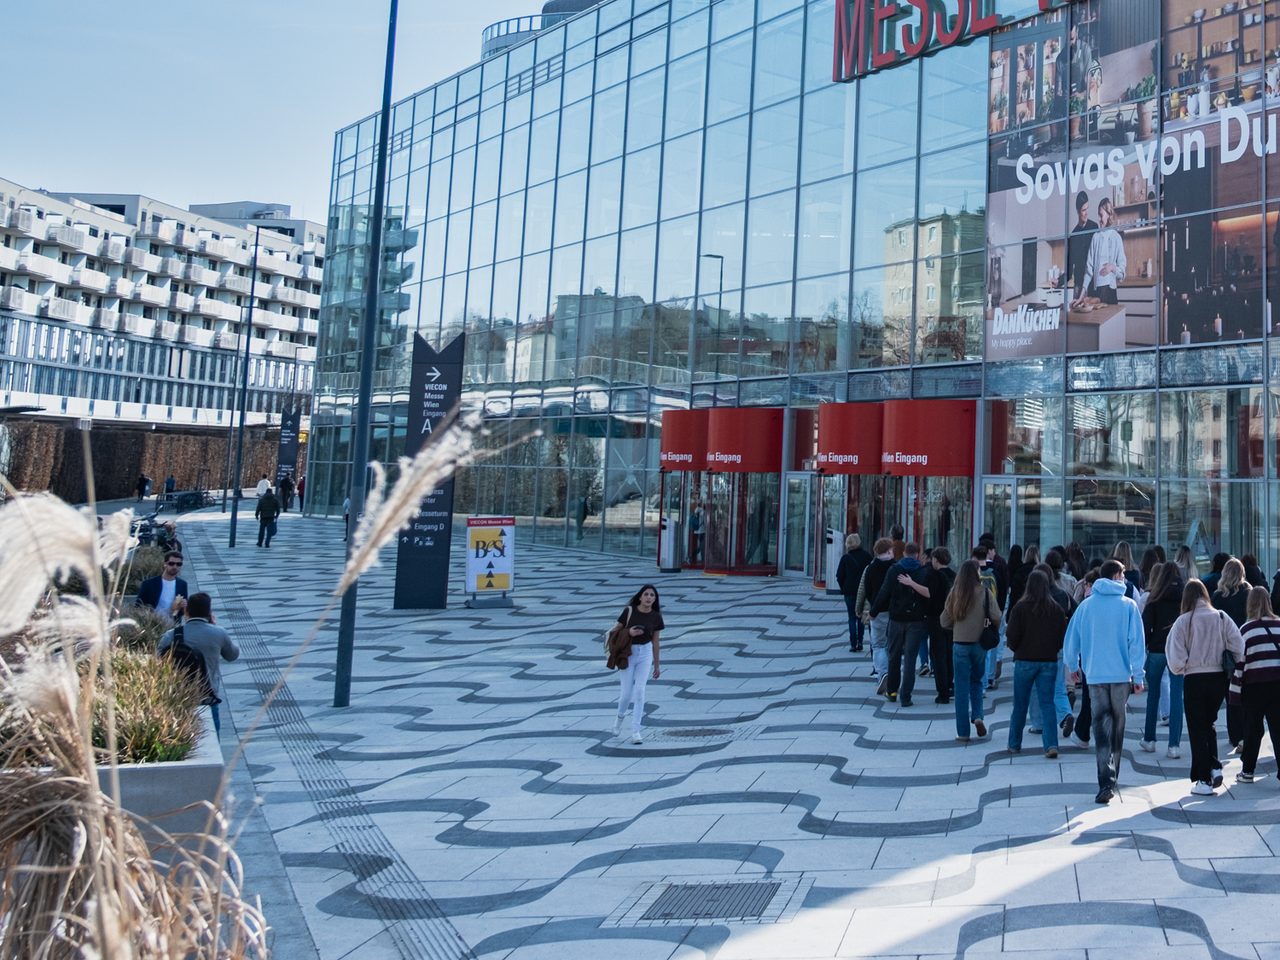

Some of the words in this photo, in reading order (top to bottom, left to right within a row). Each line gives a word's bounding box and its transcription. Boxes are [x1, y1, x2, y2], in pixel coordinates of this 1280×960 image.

[1015, 148, 1125, 205] Sowas
[1135, 130, 1206, 187] von
[424, 383, 448, 391] VIECON
[424, 392, 444, 400] Messe
[422, 409, 447, 418] Eingang
[421, 418, 433, 434] A
[668, 451, 693, 463] Eingang
[715, 451, 742, 464] Eingang
[828, 451, 859, 465] Eingang
[895, 451, 928, 466] Eingang
[414, 522, 439, 532] Eingang
[439, 522, 445, 530] D
